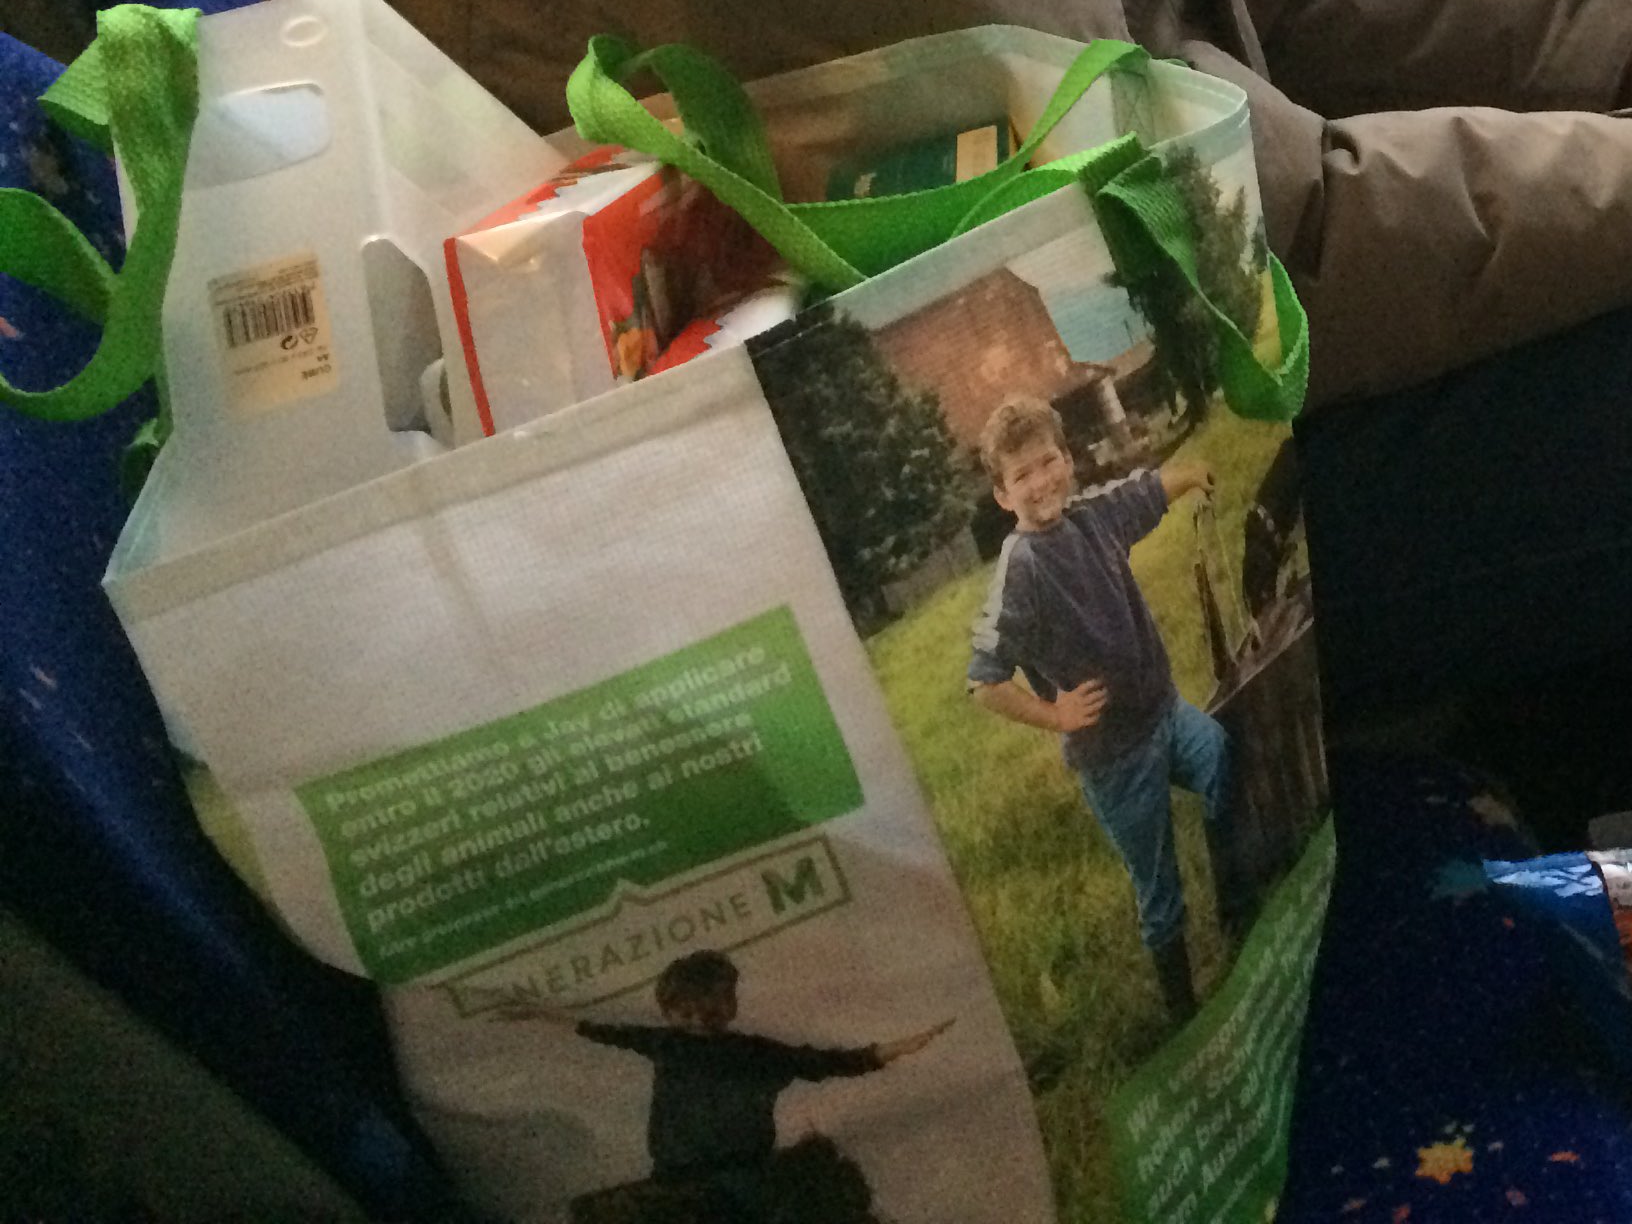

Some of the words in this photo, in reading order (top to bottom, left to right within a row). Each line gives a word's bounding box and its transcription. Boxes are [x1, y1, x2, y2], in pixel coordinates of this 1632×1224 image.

[630, 646, 770, 710] applicare
[447, 760, 521, 802] 2020
[355, 857, 435, 898] degli
[437, 813, 548, 864] animali
[551, 781, 641, 823] anche
[678, 736, 764, 776] nostri
[364, 871, 490, 931] prodotti
[498, 889, 751, 1003] NERAZIONE
[759, 856, 825, 916] M
